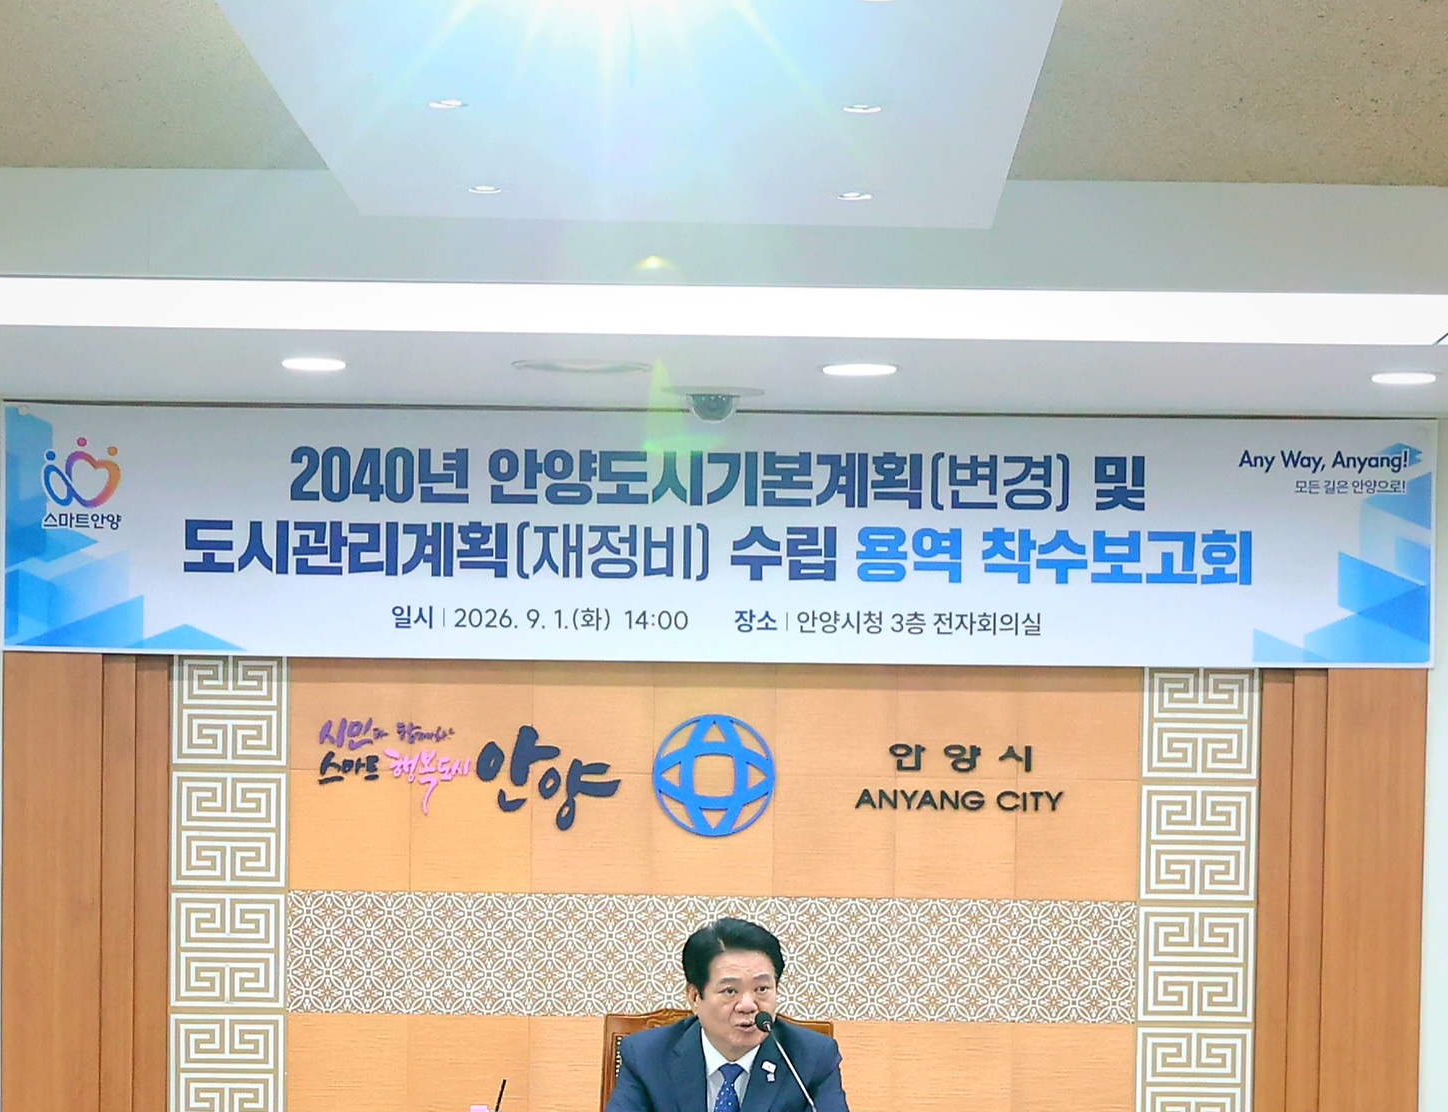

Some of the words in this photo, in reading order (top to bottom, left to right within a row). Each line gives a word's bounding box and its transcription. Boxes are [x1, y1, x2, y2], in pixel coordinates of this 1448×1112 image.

[1238, 449, 1275, 473] Any
[1281, 450, 1326, 474] Way,
[1332, 450, 1408, 474] Anyang!
[290, 445, 469, 504] 2040년
[488, 447, 1071, 512] 안양도시기본계획(변경)
[1094, 455, 1147, 512] 및
[1295, 480, 1320, 494] 모든
[1324, 480, 1348, 494] 길은
[1352, 480, 1406, 494] 안양으로!
[43, 512, 122, 531] 스마트안양
[183, 519, 710, 582] 도시관리계획(재정비)
[730, 525, 838, 582] 수립
[855, 526, 963, 584] 용역
[982, 528, 1253, 586] 착수보고회
[392, 605, 433, 629] 일시
[454, 608, 518, 629] 2026.
[526, 609, 545, 629] 9.
[625, 610, 688, 630] 14:00
[735, 610, 777, 633] 장소
[797, 611, 883, 634] 안양시청
[891, 613, 927, 635] 3층
[933, 612, 1042, 636] 전자회의실
[318, 751, 379, 785] 스마트
[384, 748, 471, 815] 행복도시
[476, 725, 621, 830] 안양
[855, 788, 985, 811] ANYANG
[996, 790, 1064, 811] CITY
